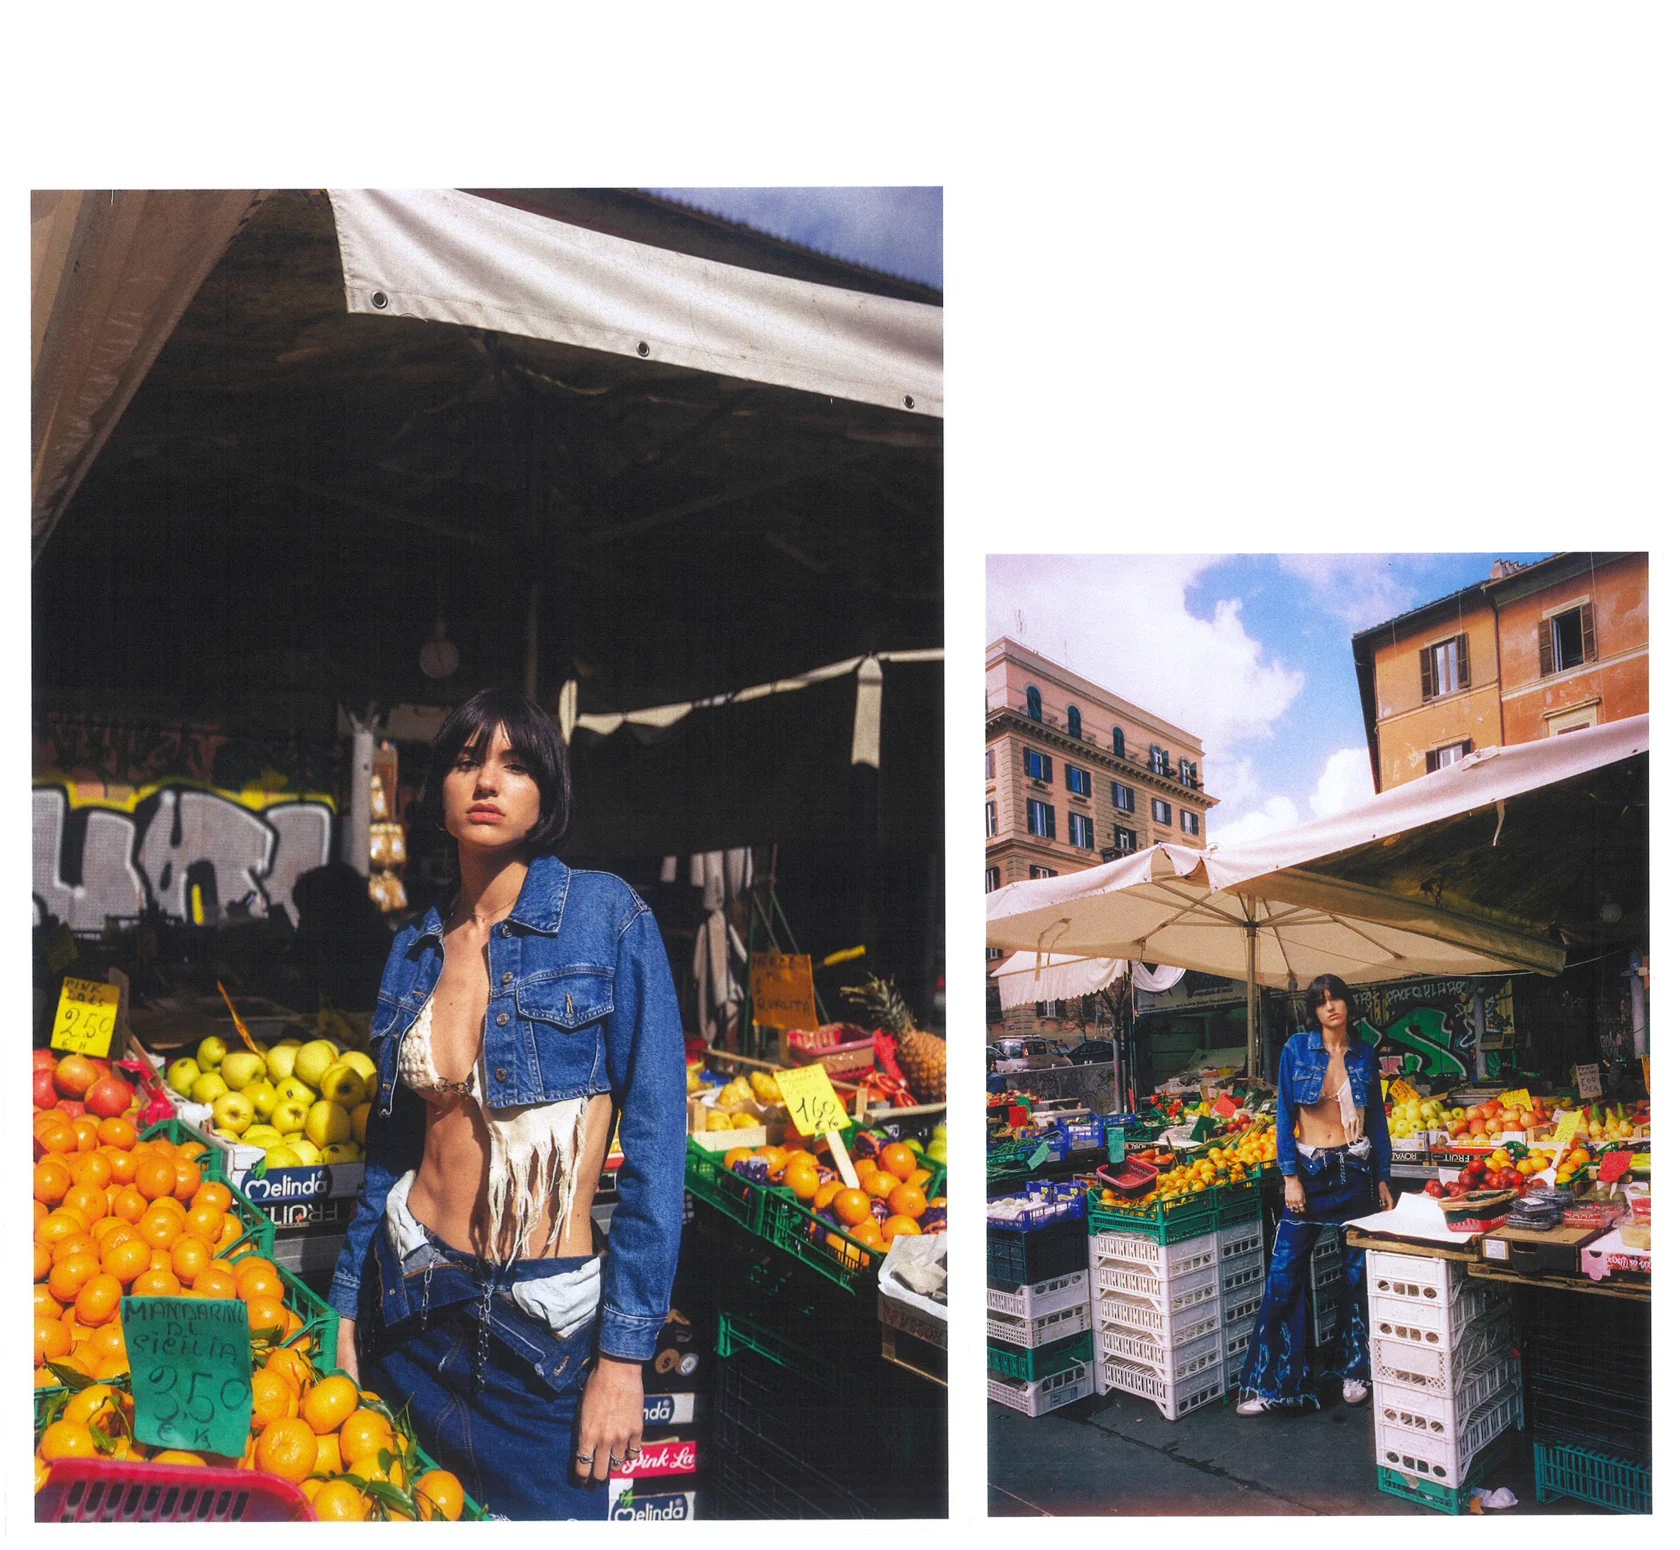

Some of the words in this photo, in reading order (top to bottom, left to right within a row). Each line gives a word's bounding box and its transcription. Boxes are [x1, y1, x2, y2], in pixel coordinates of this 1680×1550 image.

[1444, 1153, 1470, 1162] FRUIT
[245, 1172, 328, 1200] Melinda
[124, 1300, 245, 1323] MANDARINI
[167, 1321, 197, 1336] DI
[157, 1422, 177, 1443] €
[621, 1447, 670, 1475] Pink
[614, 1501, 684, 1521] Melinda
